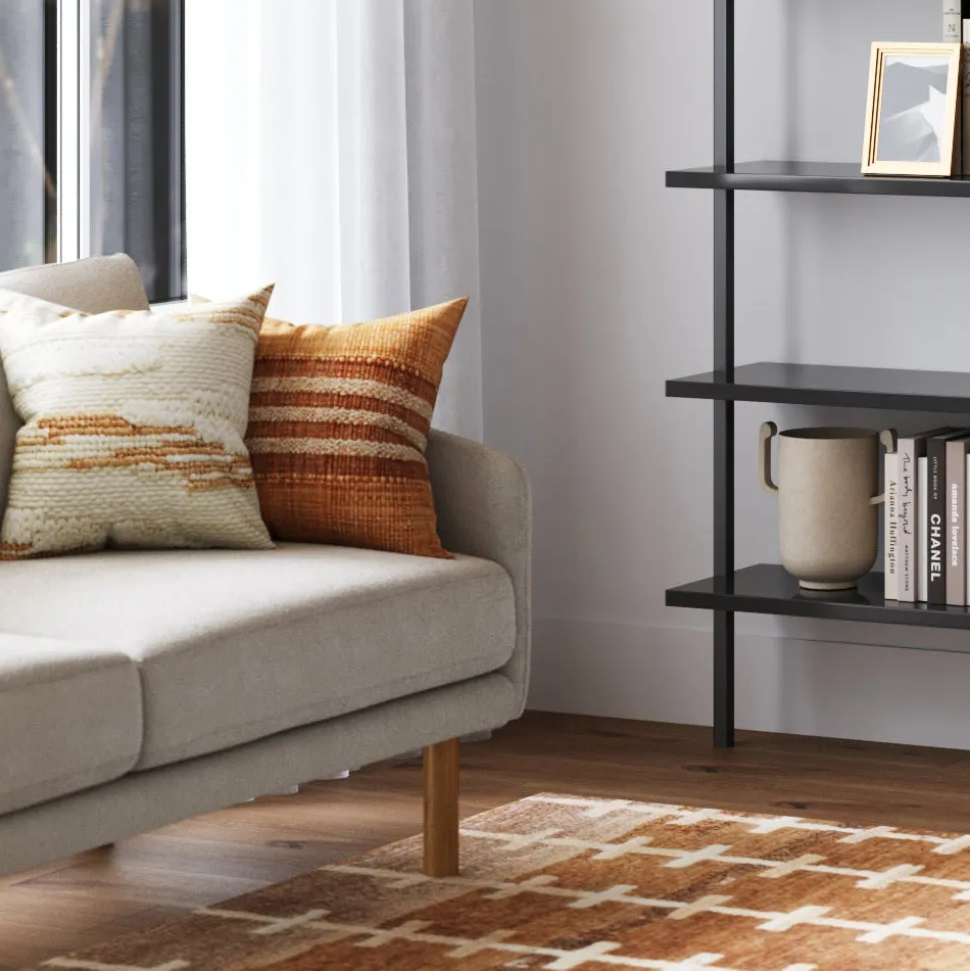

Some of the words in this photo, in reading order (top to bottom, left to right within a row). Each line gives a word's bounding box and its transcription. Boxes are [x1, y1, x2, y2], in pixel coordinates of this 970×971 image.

[889, 480, 897, 518] Arianna
[951, 483, 959, 523] amanda
[886, 521, 898, 574] Huffington
[930, 513, 941, 582] CHANEL
[951, 525, 960, 567] lovelace
